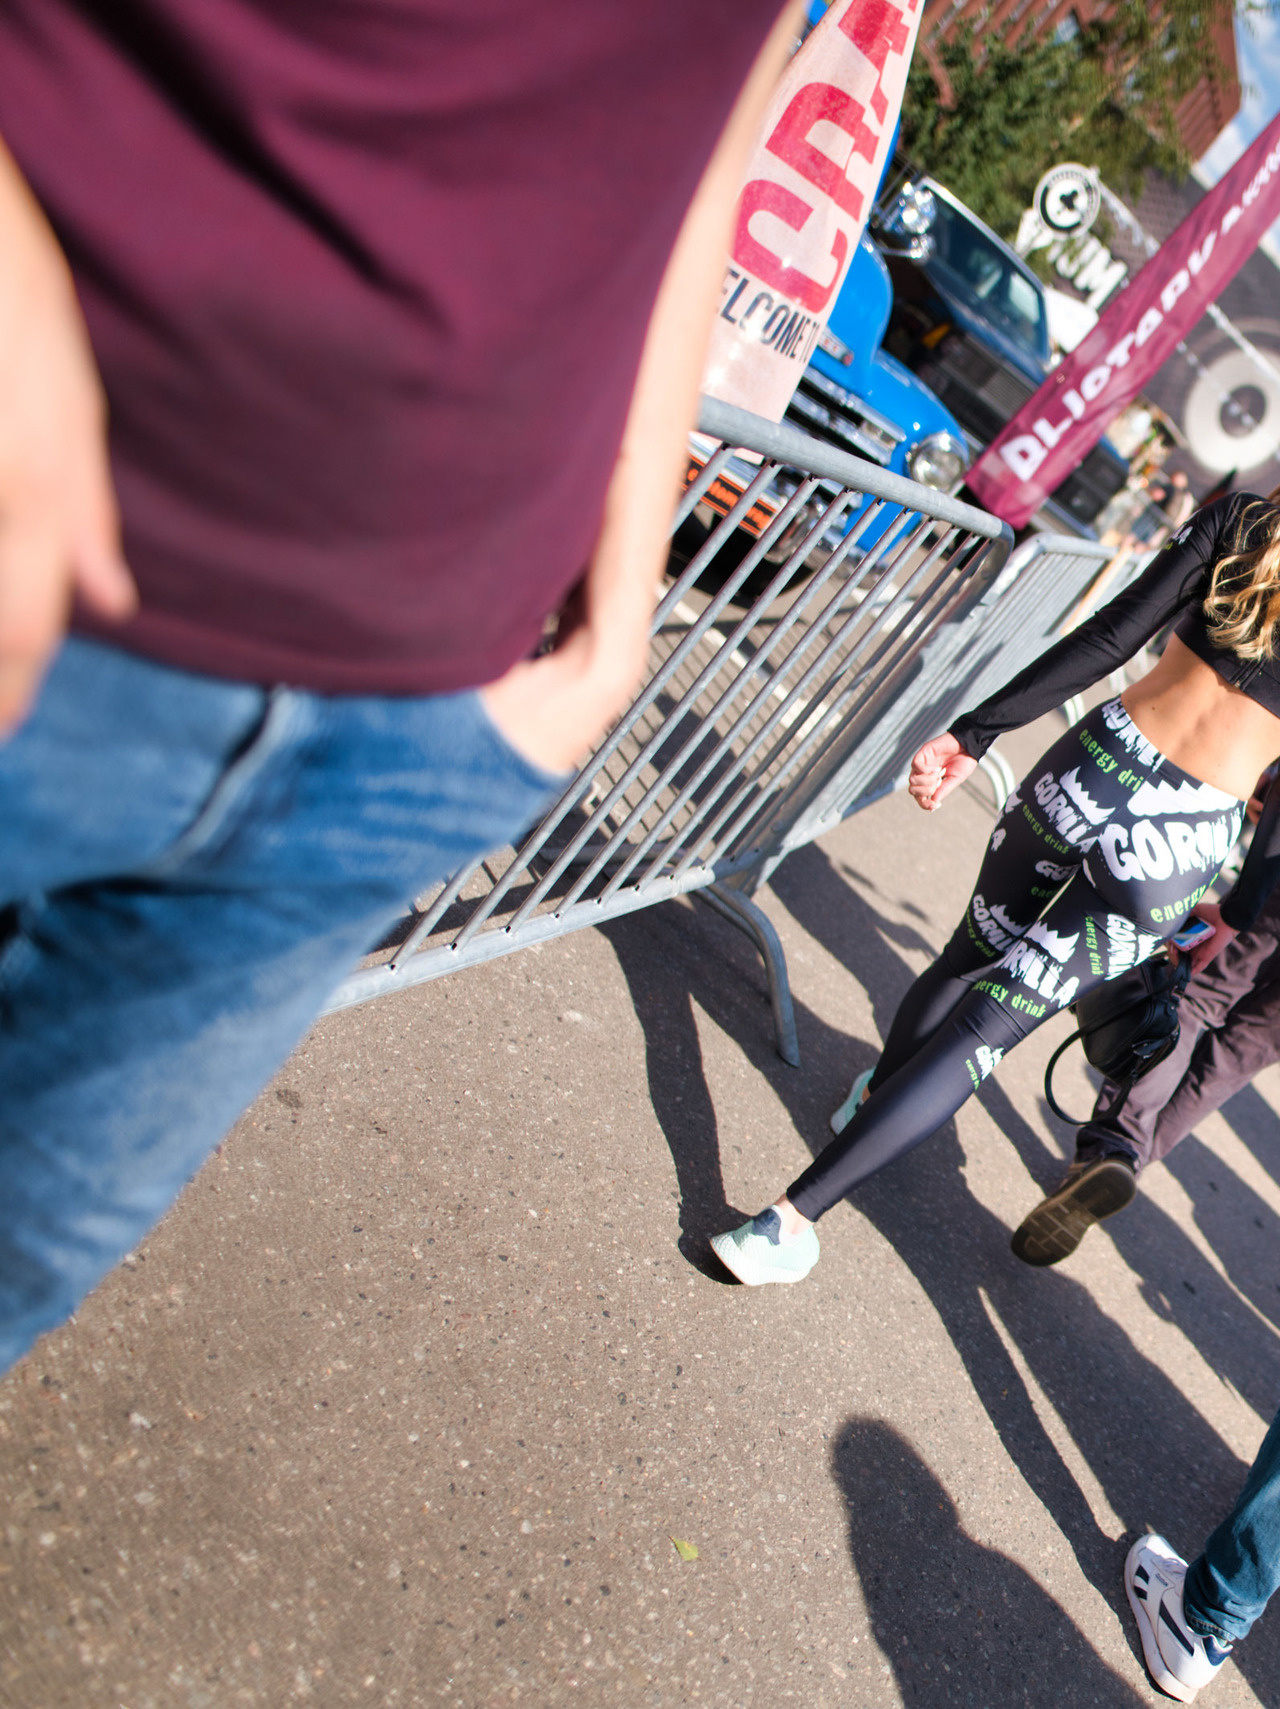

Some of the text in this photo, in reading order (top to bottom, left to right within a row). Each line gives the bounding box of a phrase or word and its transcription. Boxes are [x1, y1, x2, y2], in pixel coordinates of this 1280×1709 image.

[733, 0, 916, 314] CRA
[717, 267, 811, 360] ELCOME
[1079, 729, 1144, 792] energy dri
[972, 980, 1046, 1018] nergy drink
